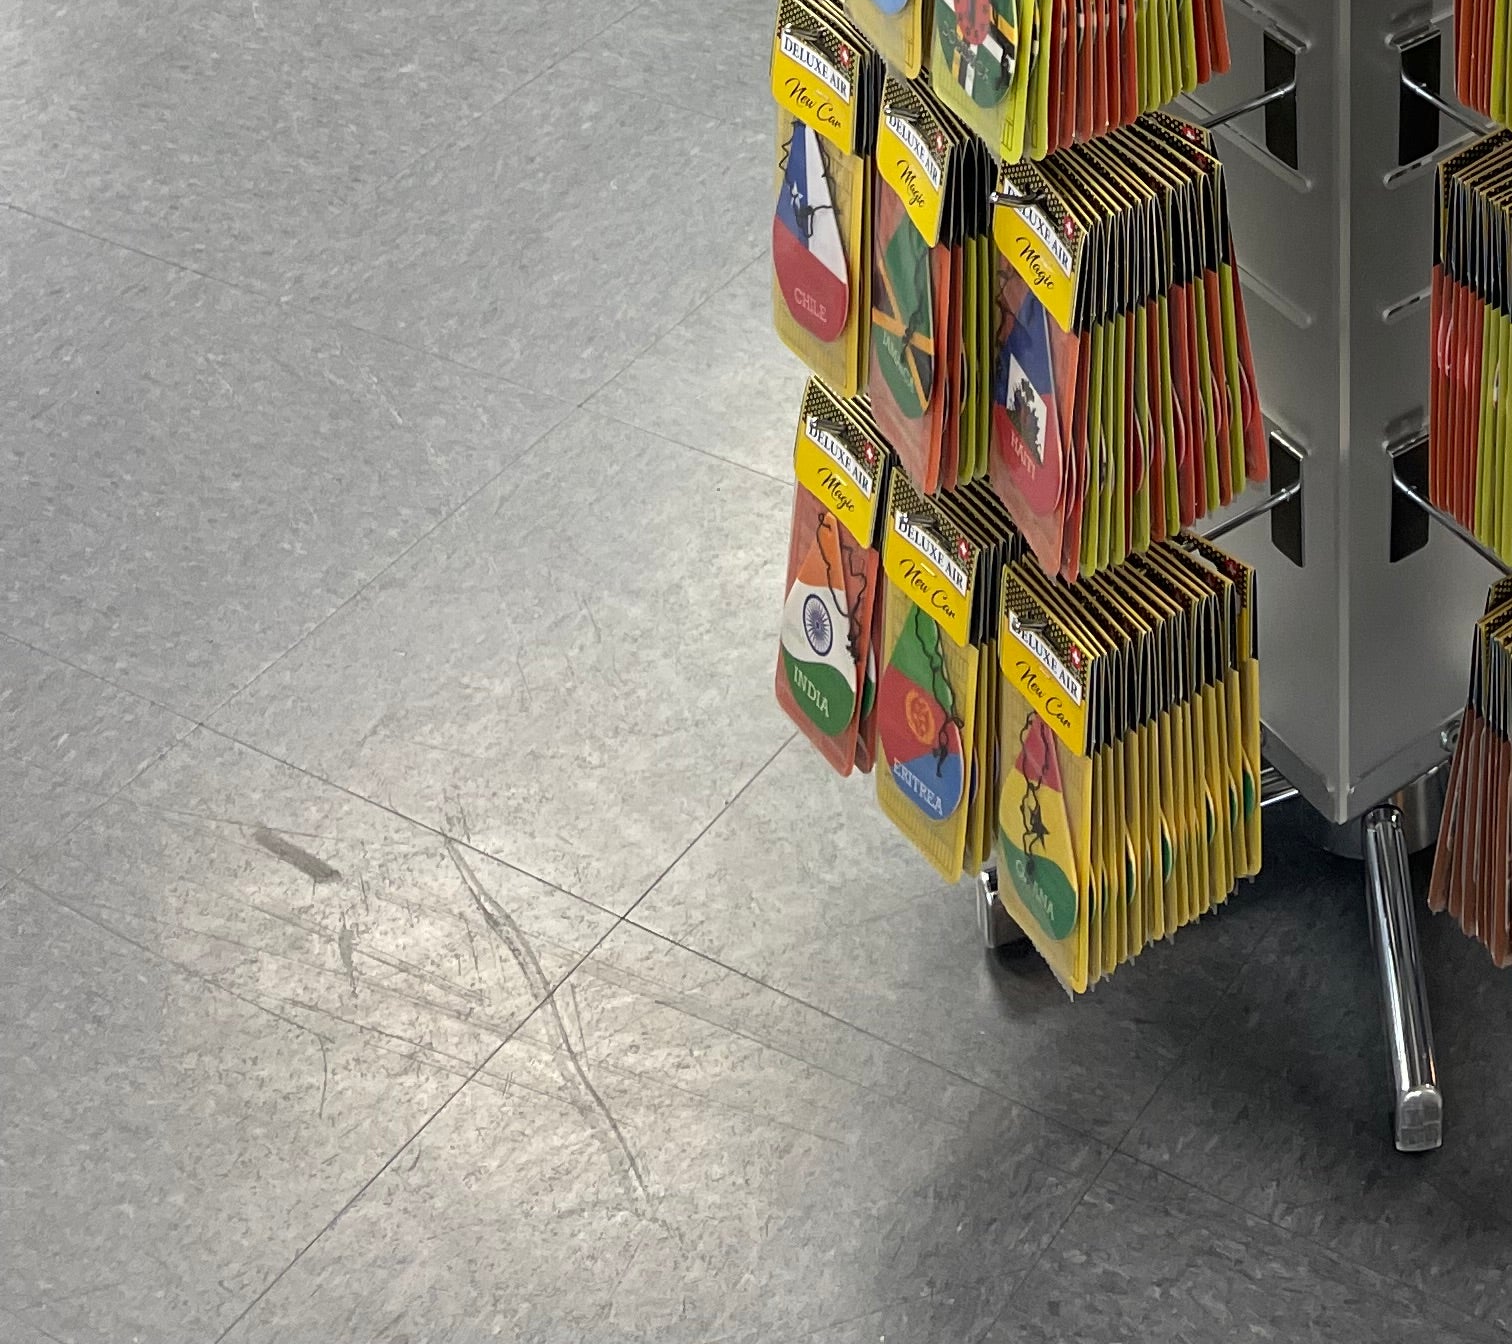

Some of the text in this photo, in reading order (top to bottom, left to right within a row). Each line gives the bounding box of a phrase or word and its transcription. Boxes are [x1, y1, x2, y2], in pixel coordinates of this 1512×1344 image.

[793, 286, 828, 324] CHILE
[791, 664, 831, 719] INDIA
[892, 757, 945, 816] ERITREA
